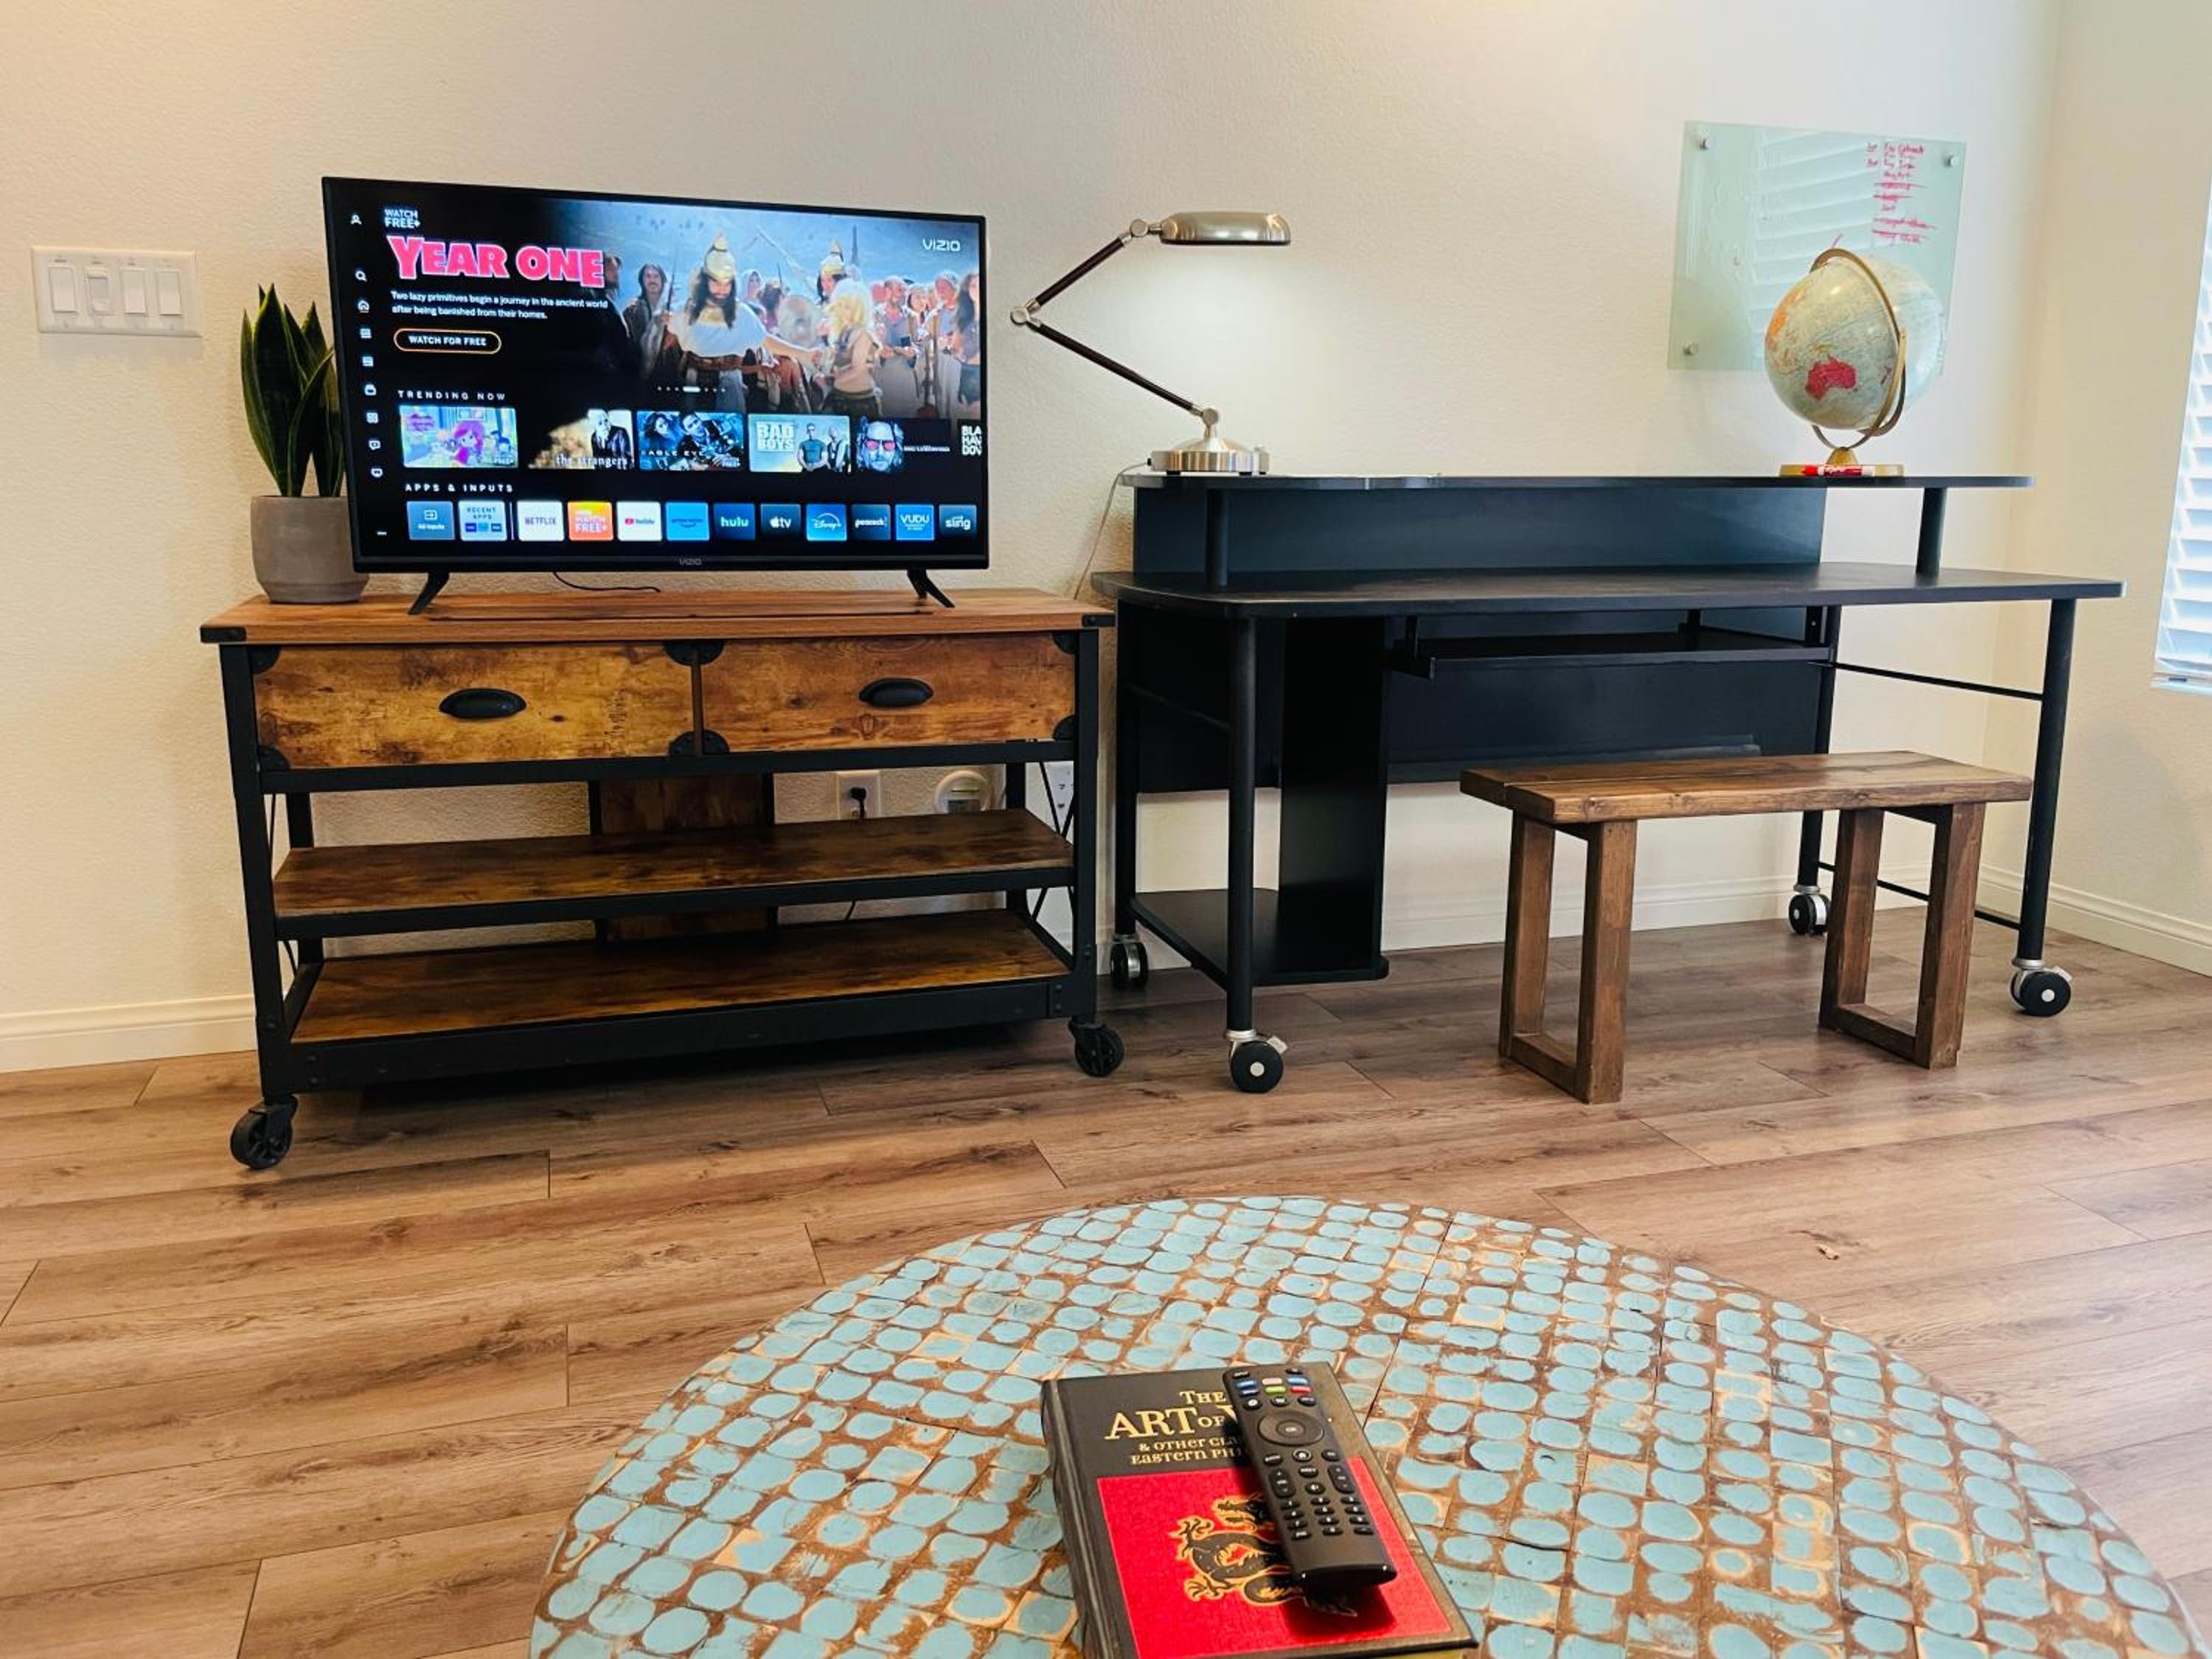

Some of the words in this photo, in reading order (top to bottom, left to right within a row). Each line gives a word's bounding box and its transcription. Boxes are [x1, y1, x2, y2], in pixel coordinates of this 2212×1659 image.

[385, 209, 418, 218] WATCH
[922, 238, 961, 251] VIZIO
[386, 235, 509, 279] YEAR
[515, 246, 605, 288] ONE
[391, 291, 408, 300] Two
[410, 292, 426, 303] lazy
[428, 293, 468, 303] primitives
[469, 294, 492, 305] begin
[500, 296, 529, 307] journey
[541, 297, 554, 306] the
[555, 298, 585, 307] ancient
[585, 300, 608, 308] world
[392, 305, 412, 313] after
[414, 306, 437, 316] being
[438, 306, 476, 317] banished
[477, 308, 497, 317] from
[498, 309, 516, 318] their
[518, 310, 548, 319] homes.
[408, 335, 441, 345] WATCH
[444, 337, 462, 345] FOR
[464, 337, 487, 346] FREE
[397, 390, 469, 400] TRENDING
[477, 393, 506, 401] NOW
[756, 422, 794, 438] BAD
[757, 438, 794, 451] BOYS
[406, 484, 440, 492] APPS
[448, 484, 456, 492] &
[463, 484, 513, 493] INPUTS
[525, 517, 556, 525] NETFLIX
[720, 516, 748, 527] hulu
[855, 518, 885, 528] peacock
[900, 514, 930, 524] VUDU
[945, 515, 970, 530] sling
[1180, 1391, 1226, 1405] THE
[1105, 1407, 1198, 1440] ART
[1197, 1415, 1225, 1428] OF
[1138, 1443, 1150, 1453] &
